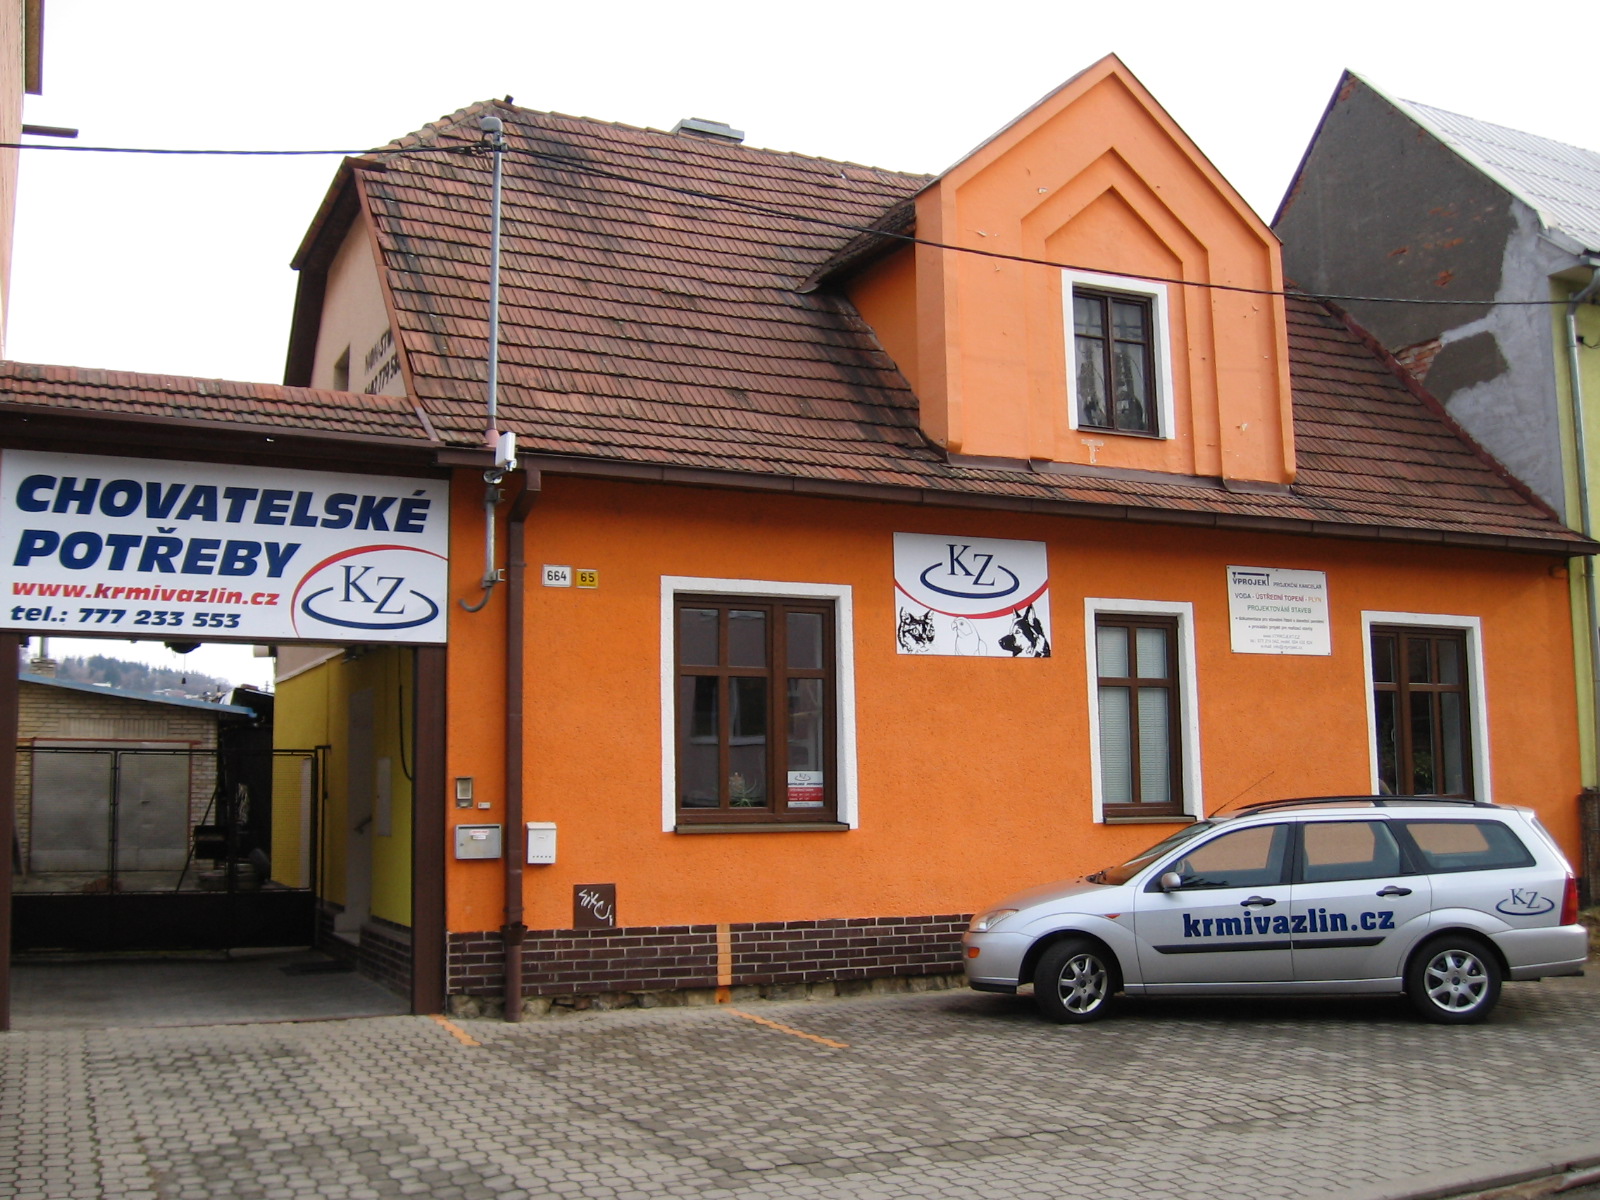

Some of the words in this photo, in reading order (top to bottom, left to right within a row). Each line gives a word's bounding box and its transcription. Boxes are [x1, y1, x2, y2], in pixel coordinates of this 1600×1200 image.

[15, 474, 431, 533] CHOVATELSKÉ
[13, 527, 301, 578] POTŘEBY
[946, 544, 996, 587] KZ
[339, 564, 406, 615] KZ
[547, 570, 567, 581] 664
[580, 572, 595, 582] 65
[12, 581, 280, 606] www.krmivazlin.cz
[11, 605, 67, 622] tel.:
[78, 607, 126, 624] 777
[136, 609, 185, 626] 233
[192, 612, 241, 628] 553
[1510, 887, 1539, 910] KZ
[1183, 906, 1394, 938] krmivazlin.cz
